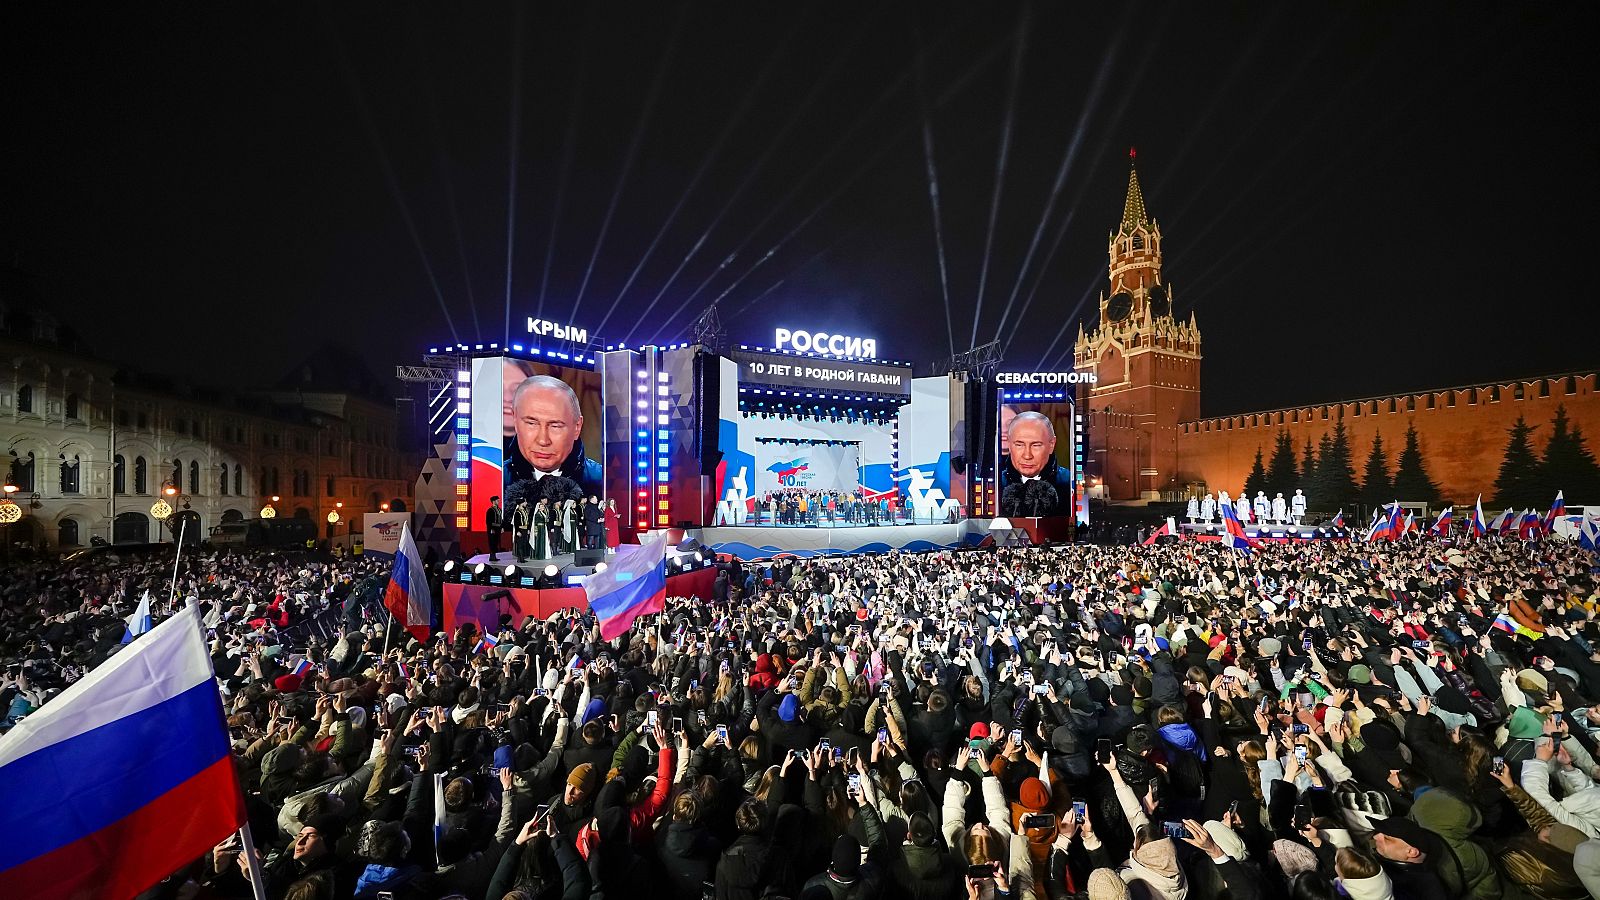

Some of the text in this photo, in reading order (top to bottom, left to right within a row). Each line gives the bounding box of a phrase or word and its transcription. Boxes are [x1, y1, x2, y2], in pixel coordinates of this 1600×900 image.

[527, 316, 587, 344] КРЫМ
[775, 328, 877, 358] РОССИЯ
[750, 363, 901, 385] 10 ЛЕТ В РОДНОЙ ГАВАНИ
[995, 372, 1098, 384] СЕВАСТОПОЛЬ
[782, 475, 796, 486] 10
